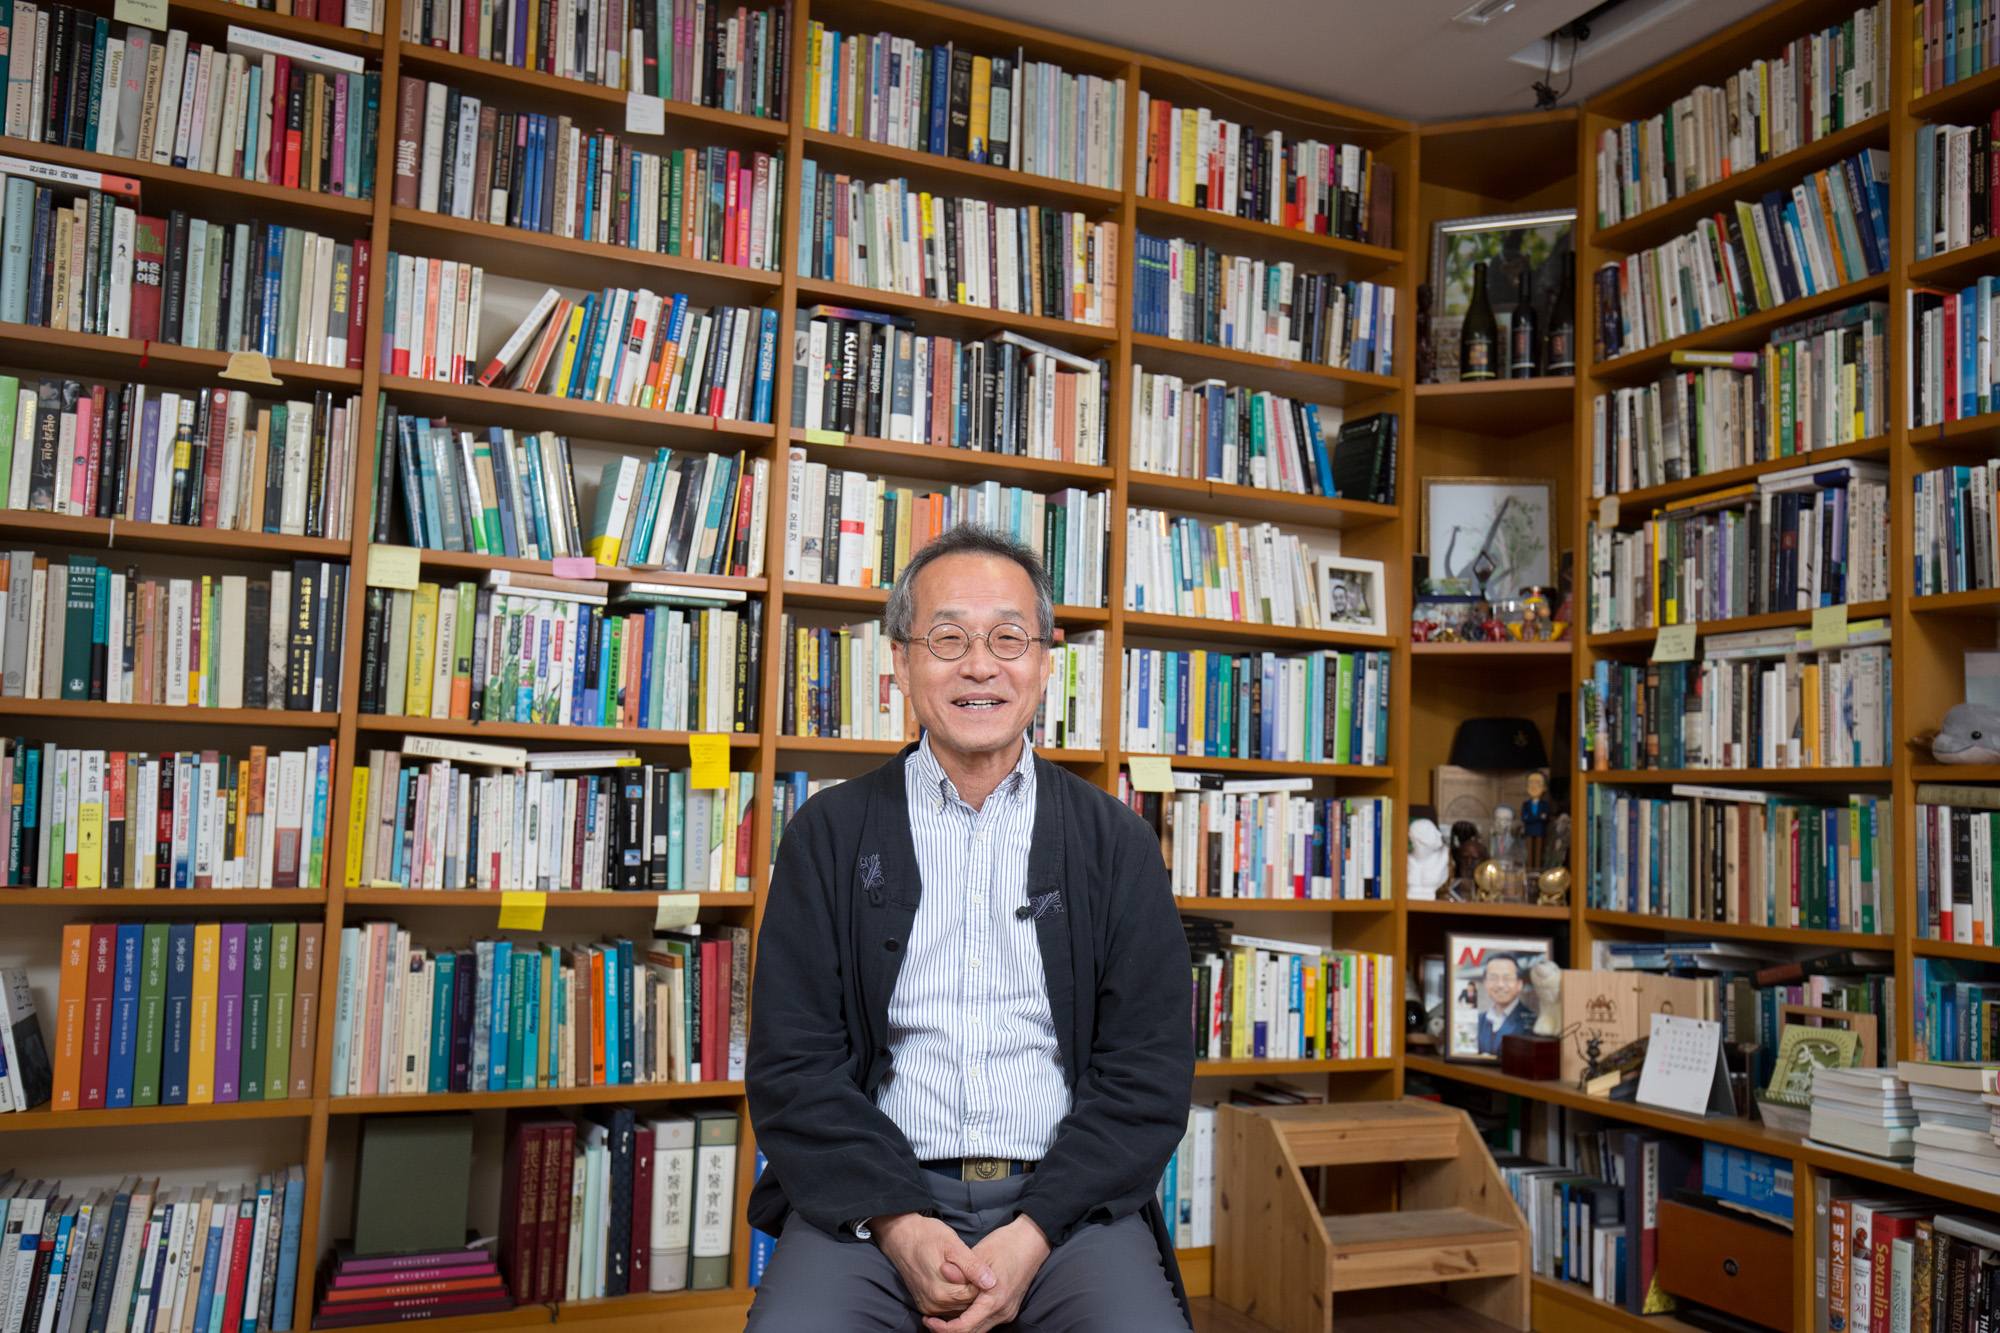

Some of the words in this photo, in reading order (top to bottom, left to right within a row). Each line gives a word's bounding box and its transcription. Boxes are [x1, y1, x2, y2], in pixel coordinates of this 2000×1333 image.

[110, 50, 123, 88] Woman
[147, 77, 157, 102] Woman
[397, 140, 417, 176] Stiffed
[445, 135, 455, 164] Journey
[662, 344, 677, 384] IRRATIONAL
[843, 332, 858, 380] KUHN
[22, 400, 36, 440] Woman
[370, 616, 378, 630] For
[415, 614, 426, 640] Study
[175, 638, 183, 673] INSECTES
[368, 633, 377, 650] Love
[366, 664, 374, 692] Insects
[414, 654, 424, 686] Insects
[610, 647, 618, 700] BUZZWORDS
[696, 799, 704, 816] BAT
[695, 822, 704, 871] ECOLOGY
[4, 1248, 16, 1276] MEANS
[22, 1258, 32, 1278] TIME
[1874, 1242, 1889, 1320] Sexualia
[14, 1296, 25, 1314] OUR
